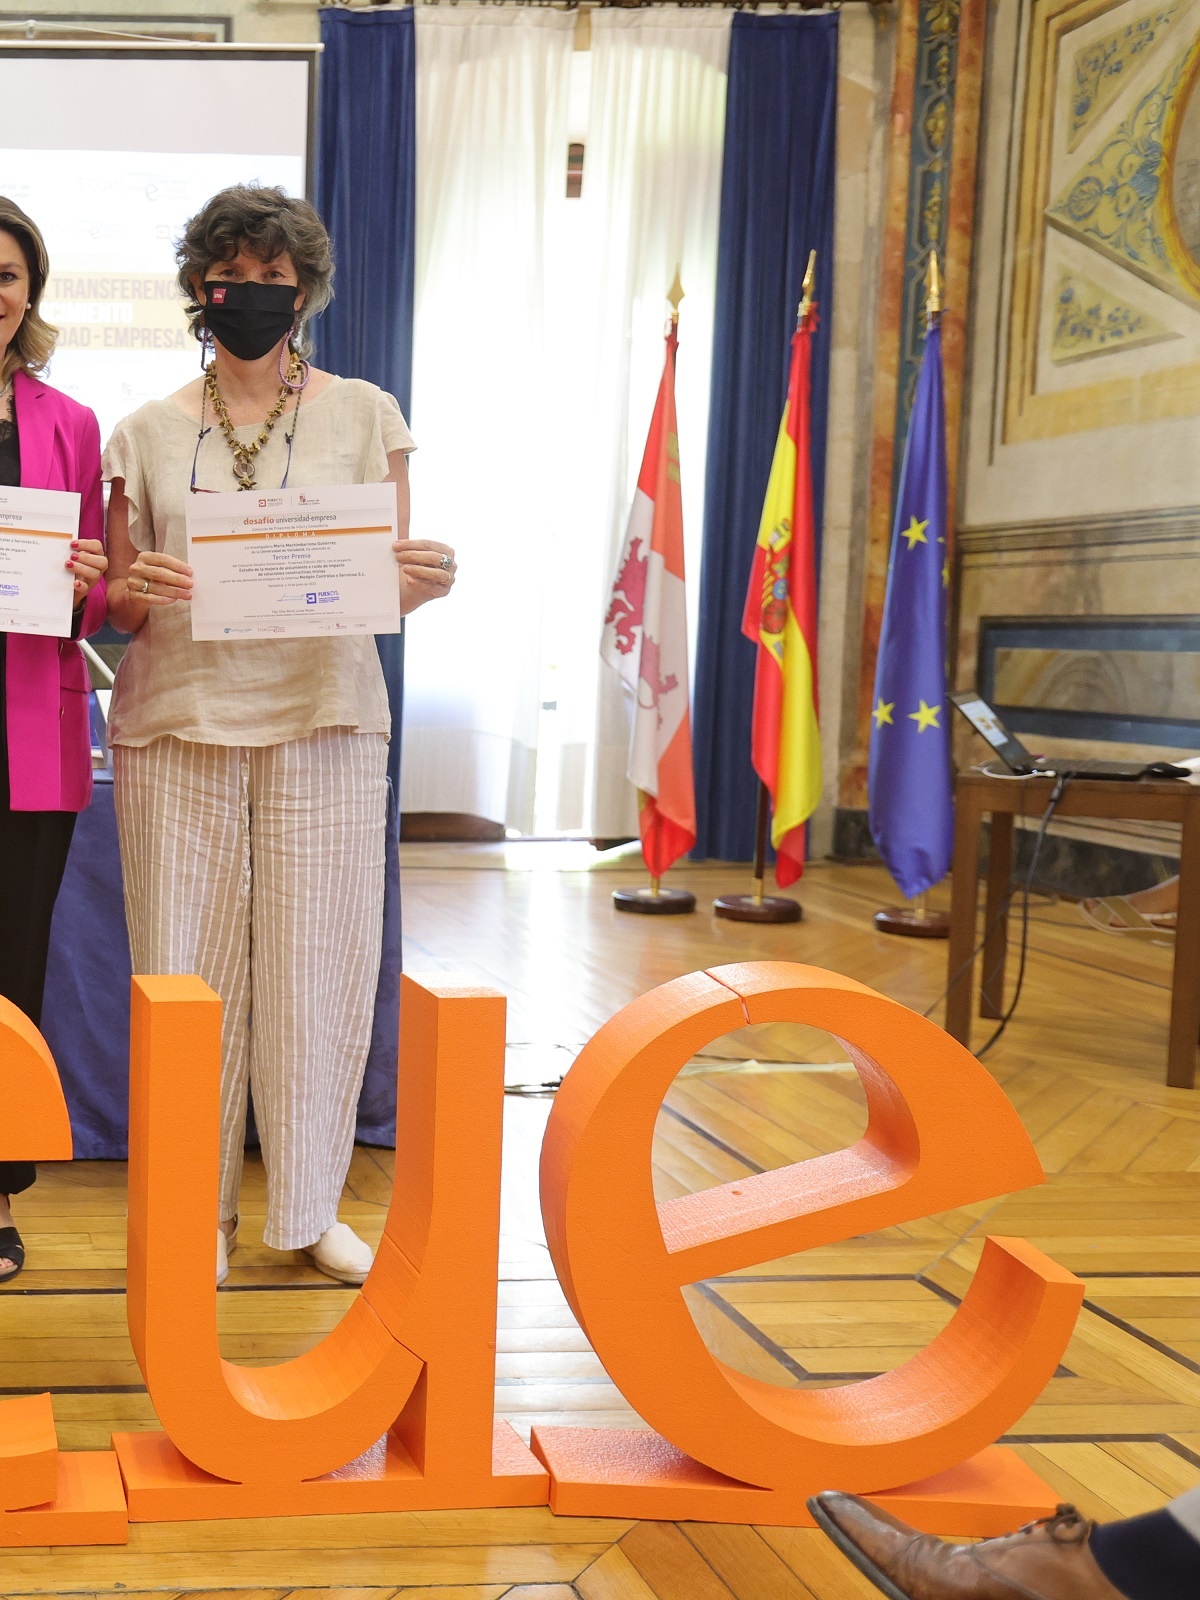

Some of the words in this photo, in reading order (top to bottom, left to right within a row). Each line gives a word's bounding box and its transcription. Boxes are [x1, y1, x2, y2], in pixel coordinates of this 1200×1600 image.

[104, 328, 186, 348] EMPRESA
[244, 517, 274, 525] desafío
[276, 514, 336, 524] universidad-empresa
